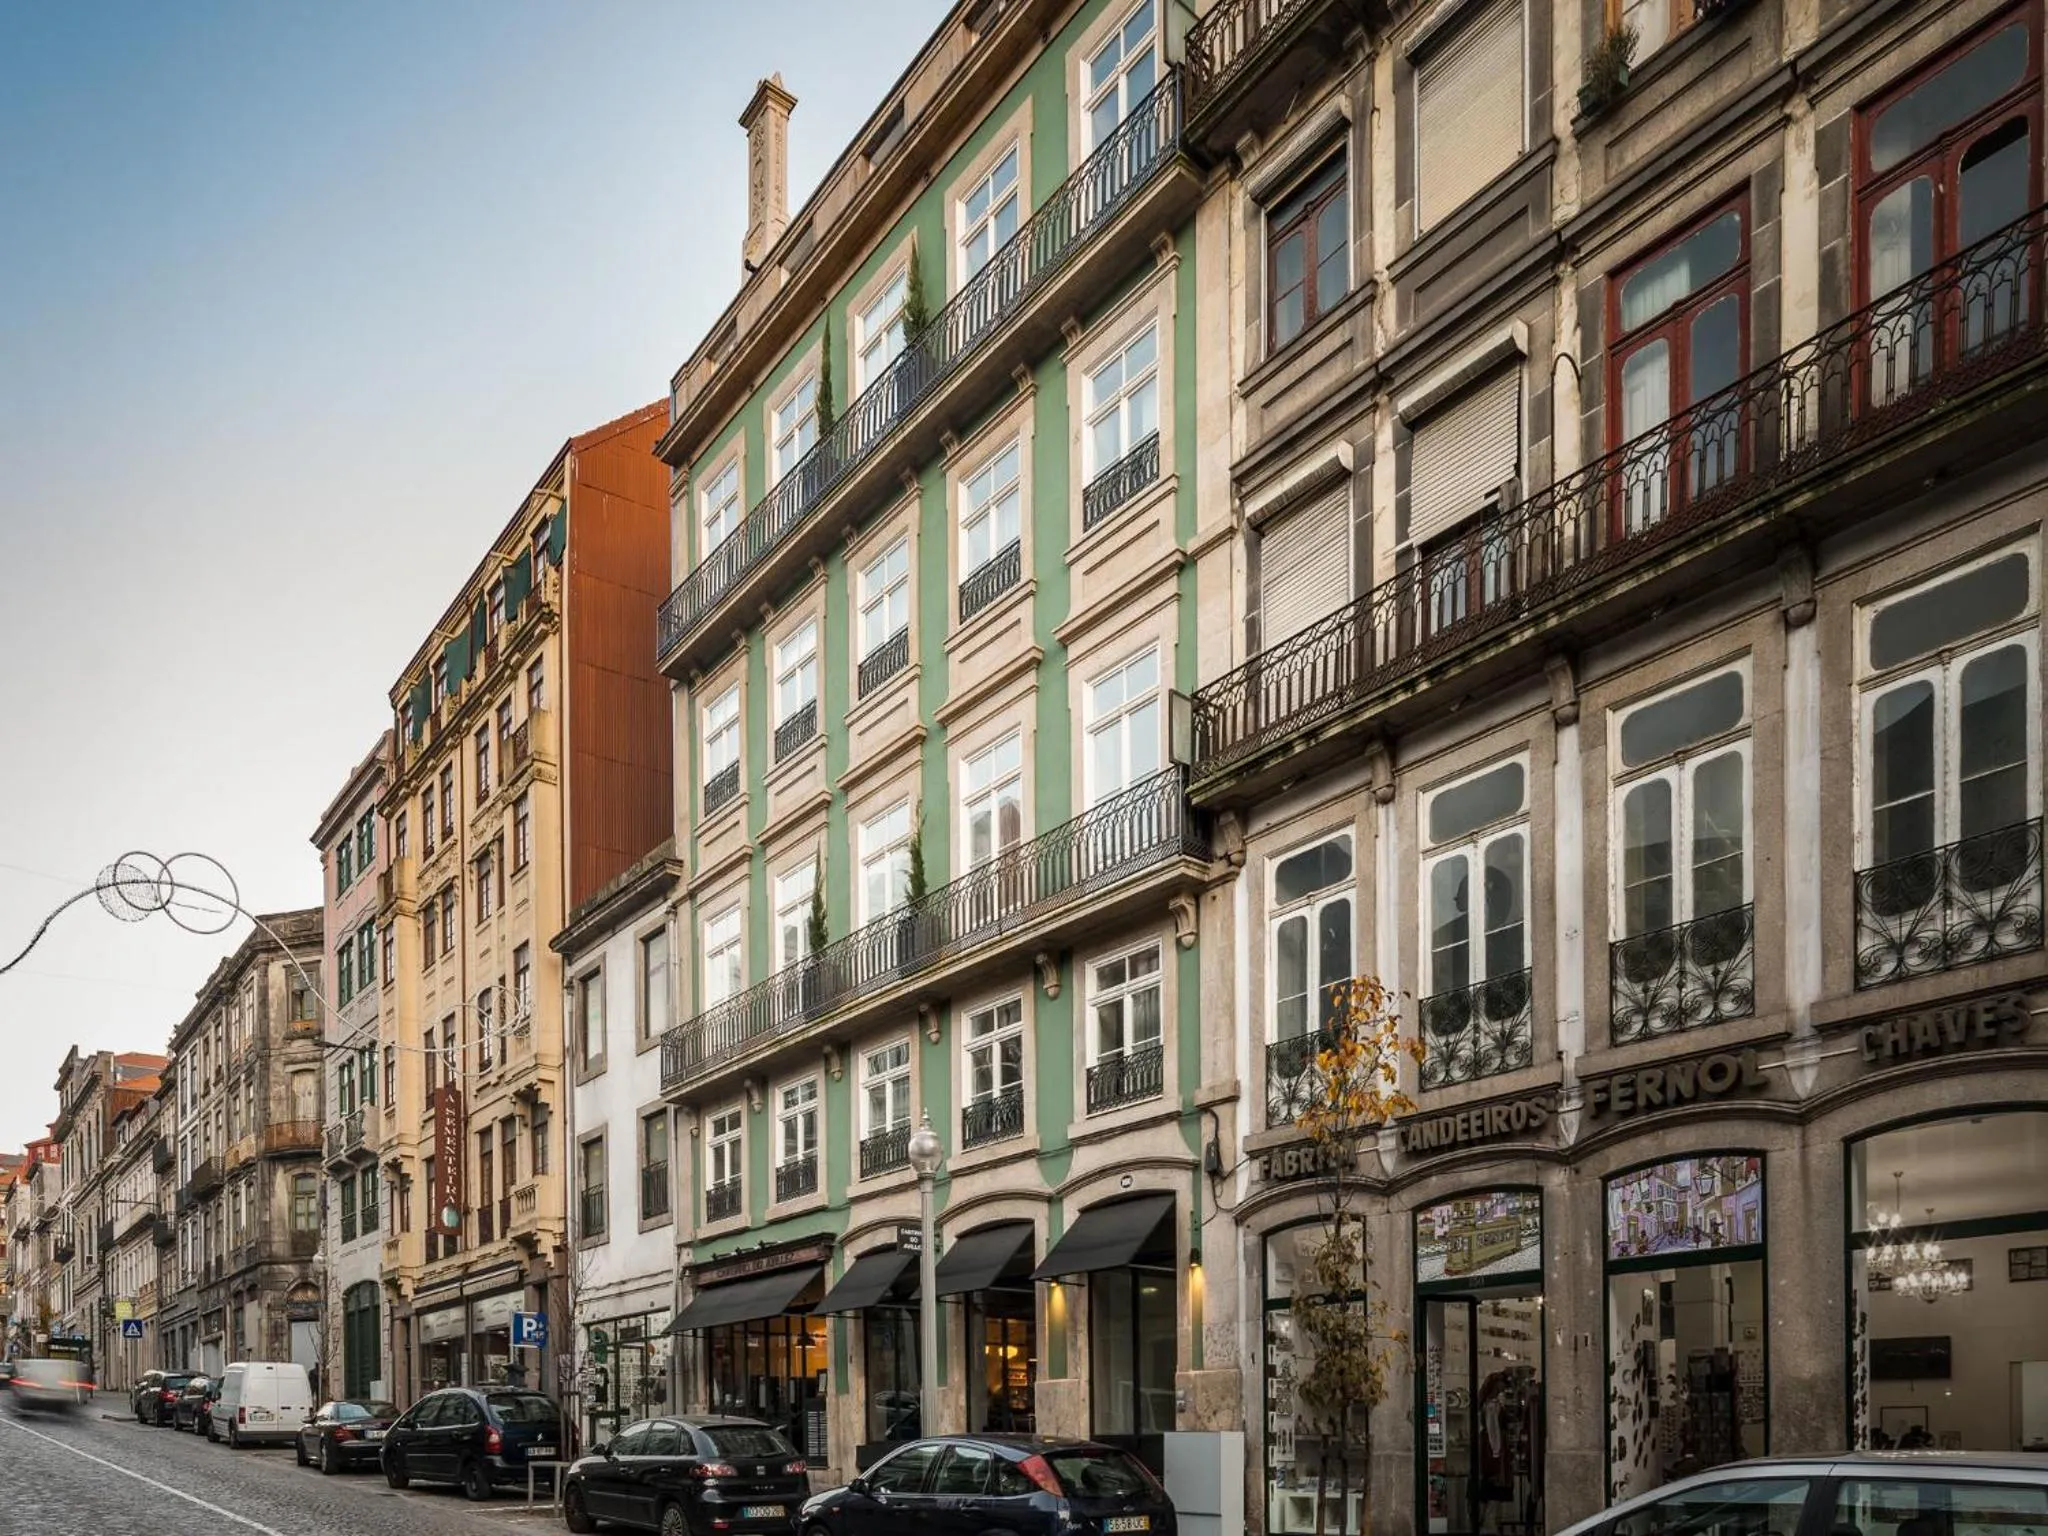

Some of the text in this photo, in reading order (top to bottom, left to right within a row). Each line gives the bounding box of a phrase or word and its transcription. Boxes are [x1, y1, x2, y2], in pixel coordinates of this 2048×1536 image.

[1397, 1096, 1550, 1153] CANDEEIROS
[1585, 1047, 1769, 1119] FERNOL
[1859, 992, 2031, 1062] CHAVES
[443, 1107, 457, 1204] SEMENTEIRA
[522, 1317, 537, 1338] P
